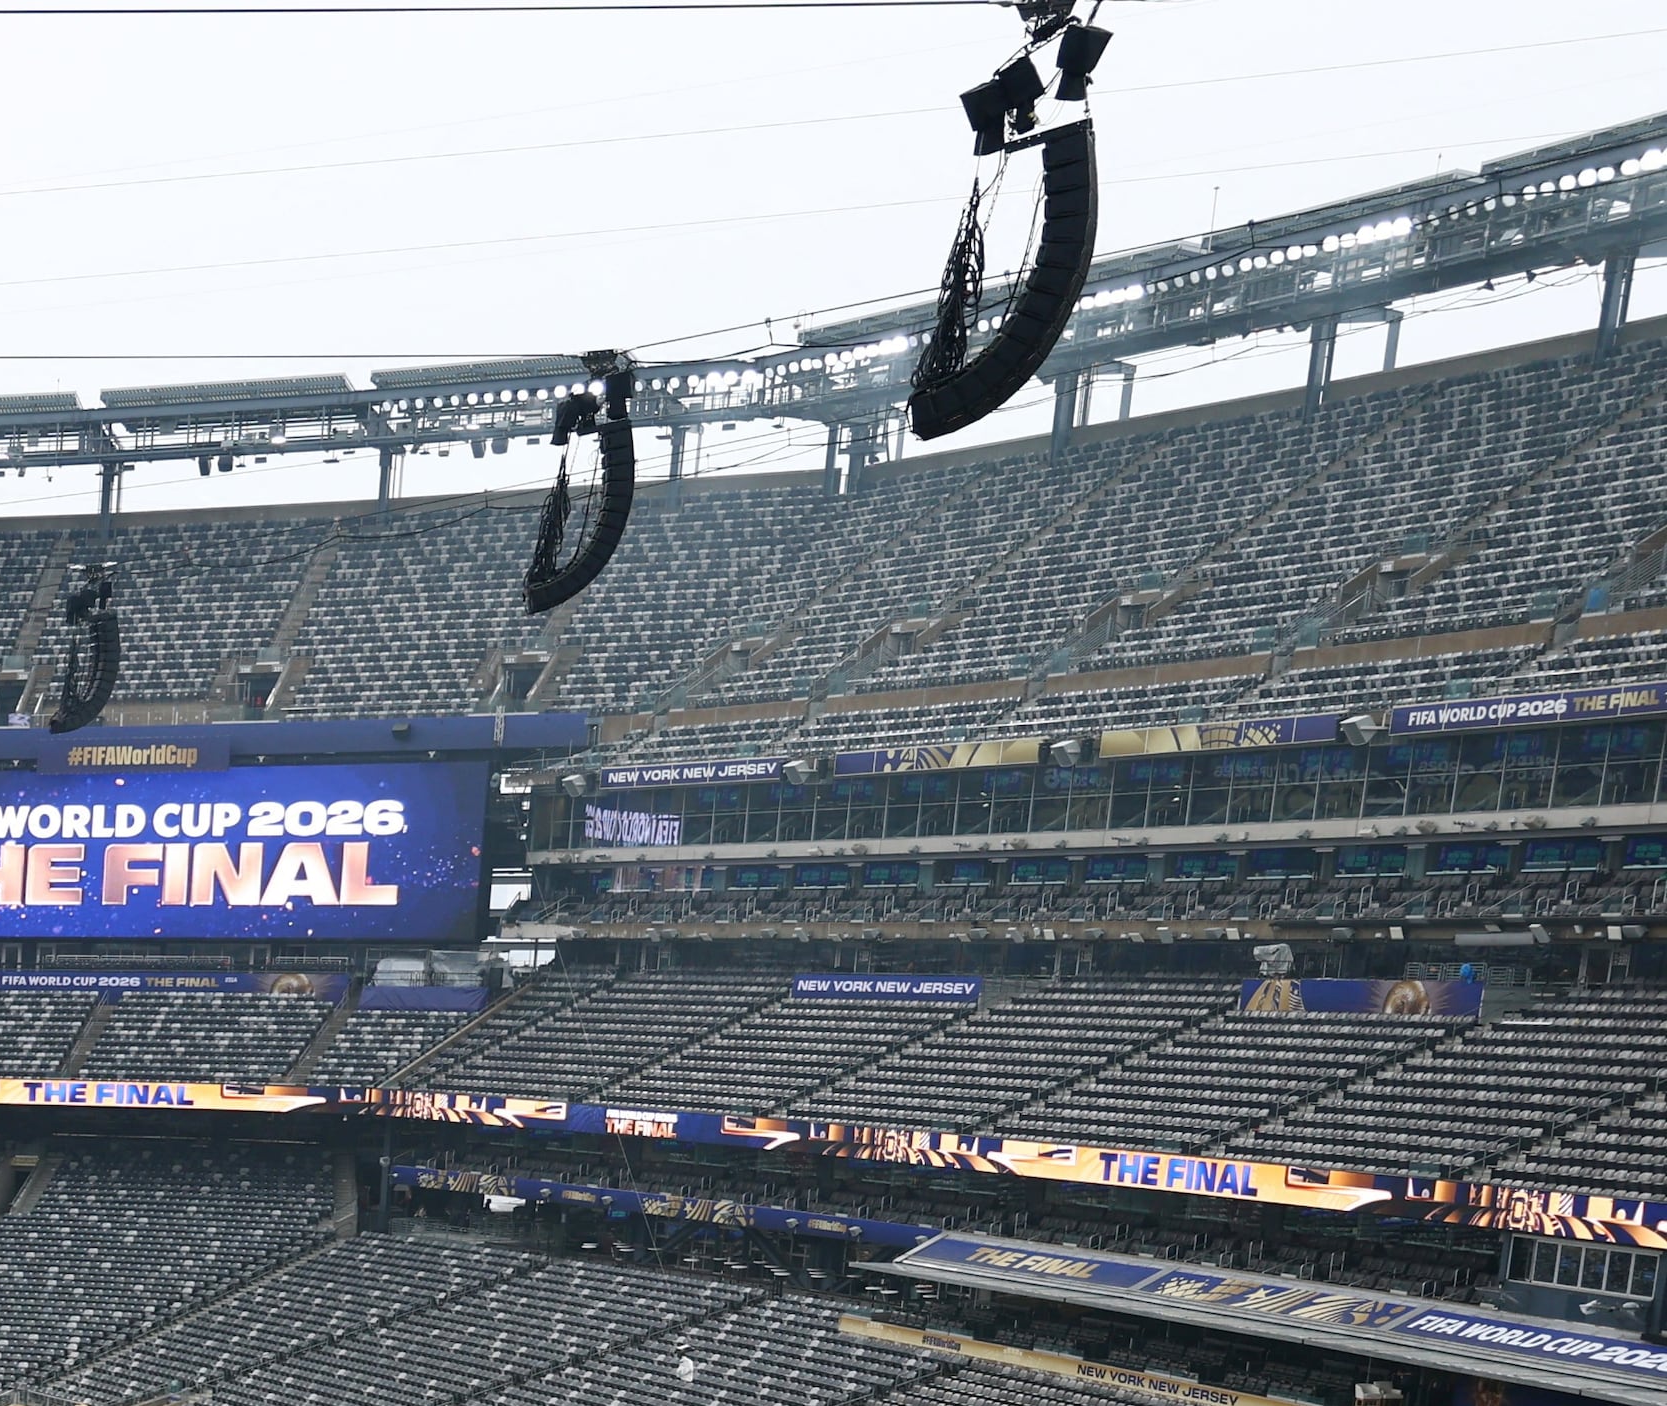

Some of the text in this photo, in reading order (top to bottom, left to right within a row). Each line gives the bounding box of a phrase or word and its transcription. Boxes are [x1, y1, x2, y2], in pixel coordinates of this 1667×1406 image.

[1408, 690, 1659, 727] FIFA WORLD CUP 2026 THE FINAL
[68, 744, 198, 768] #FIFAWorldCup
[608, 762, 777, 784] NEW YORK NEW JERSEY
[152, 801, 241, 838] CUP
[246, 800, 405, 836] 2026
[101, 842, 399, 906] FINAL
[2, 976, 29, 985] FIFA
[32, 976, 73, 986] WORLD
[74, 976, 97, 986] CUP
[98, 976, 141, 987] 2026
[146, 977, 175, 987] THE
[177, 977, 219, 987] FINAL
[797, 980, 975, 995] NEW YORK NEW JERSEY
[23, 1082, 193, 1106] THE FINAL
[605, 1117, 676, 1138] THE FINAL
[1099, 1152, 1258, 1197] THE FINAL
[971, 1247, 1097, 1278] THE FINAL
[1407, 1315, 1468, 1335] FIFA
[1458, 1322, 1551, 1349] WORLD
[1543, 1335, 1603, 1356] CUP
[1077, 1364, 1239, 1406] NEW YORK NEW JERSEY
